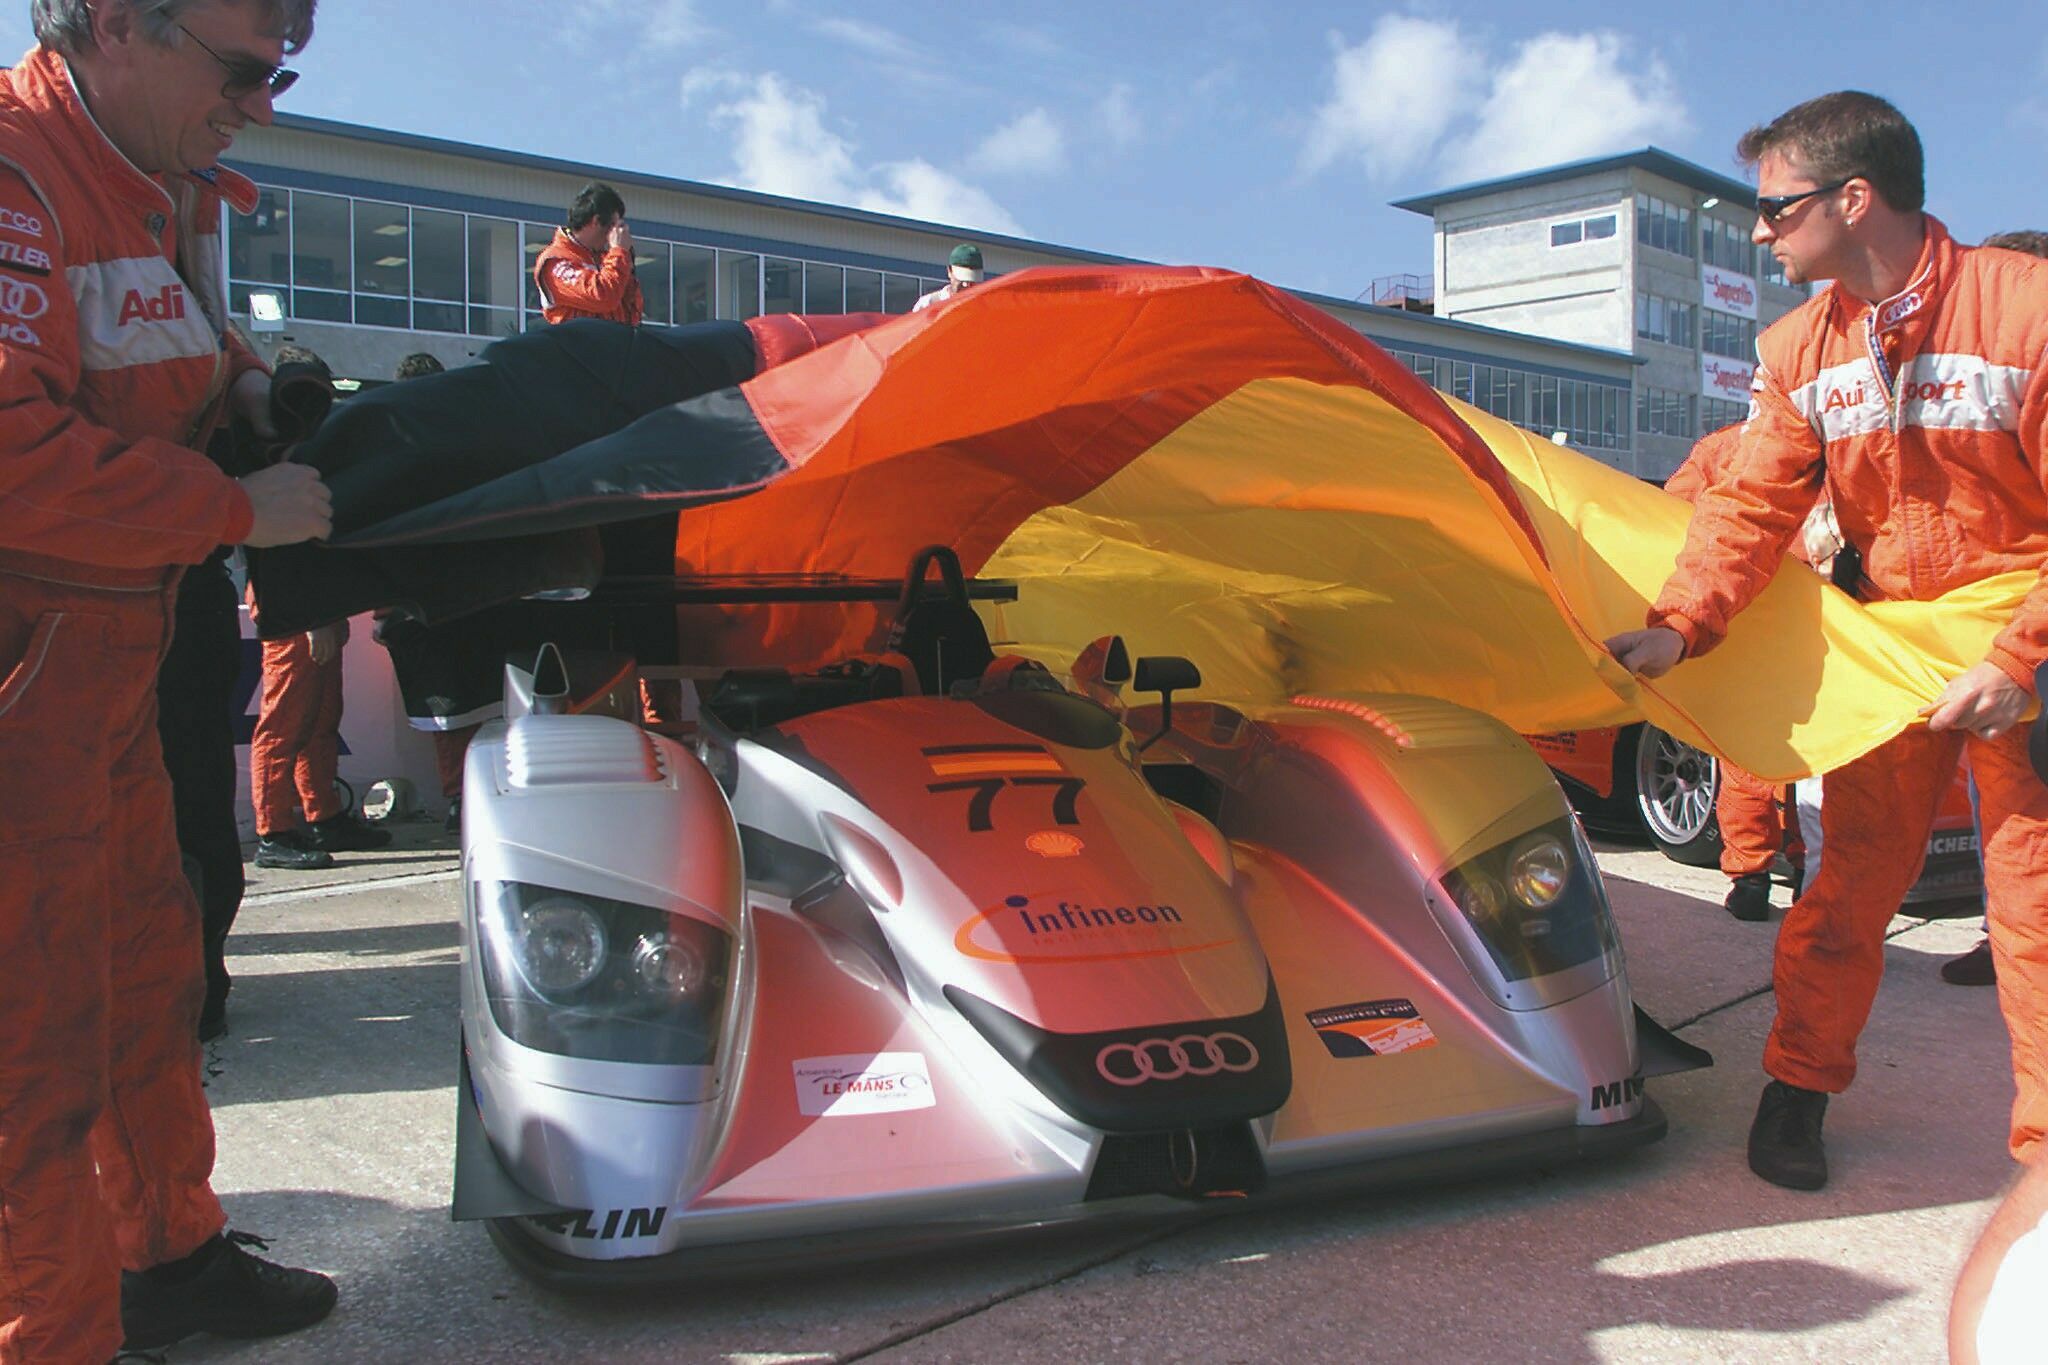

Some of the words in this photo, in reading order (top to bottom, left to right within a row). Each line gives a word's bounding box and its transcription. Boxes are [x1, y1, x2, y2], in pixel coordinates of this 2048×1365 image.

[118, 284, 185, 327] Adi
[1824, 380, 1865, 412] Aui
[1903, 379, 1966, 403] port
[927, 776, 1086, 832] 77
[823, 1082, 842, 1095] LE
[847, 1079, 894, 1093] MANS
[551, 1206, 668, 1240] LIN
